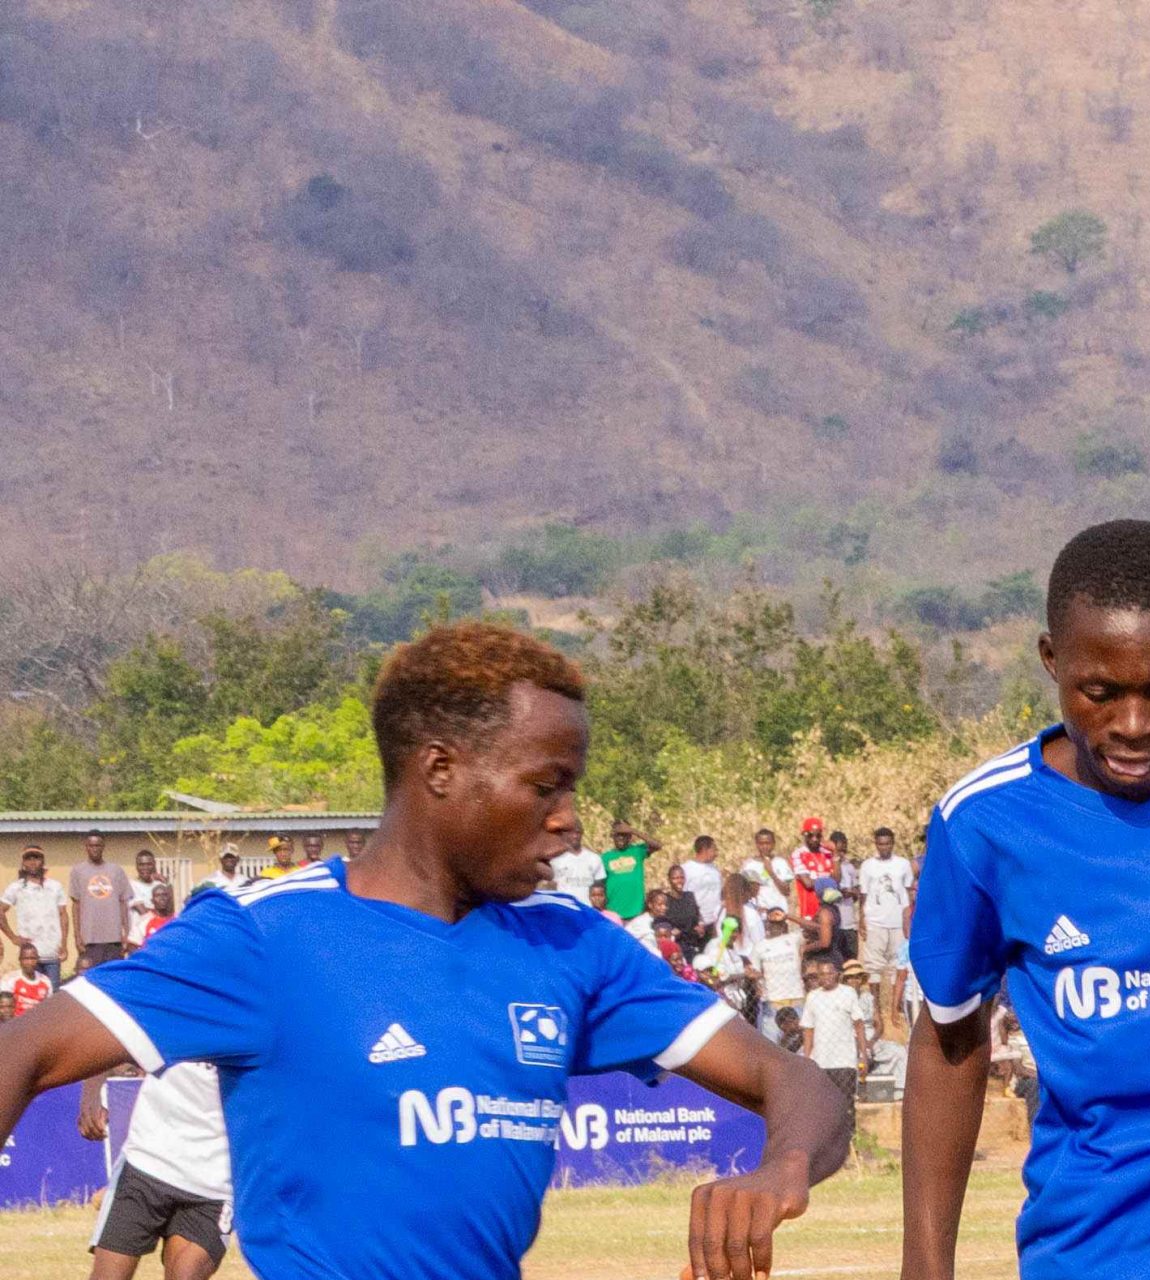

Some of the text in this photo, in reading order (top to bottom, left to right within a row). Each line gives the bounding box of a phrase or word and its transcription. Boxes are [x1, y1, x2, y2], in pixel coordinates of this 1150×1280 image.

[1045, 932, 1091, 955] adidas
[1055, 966, 1121, 1020] NB
[1126, 990, 1149, 1011] of
[369, 1044, 427, 1063] adidas
[398, 1086, 477, 1146] NB
[477, 1094, 564, 1118] National Ba
[615, 1107, 716, 1125] National Bank
[479, 1119, 500, 1139] of
[616, 1126, 712, 1144] of Malawi plc
